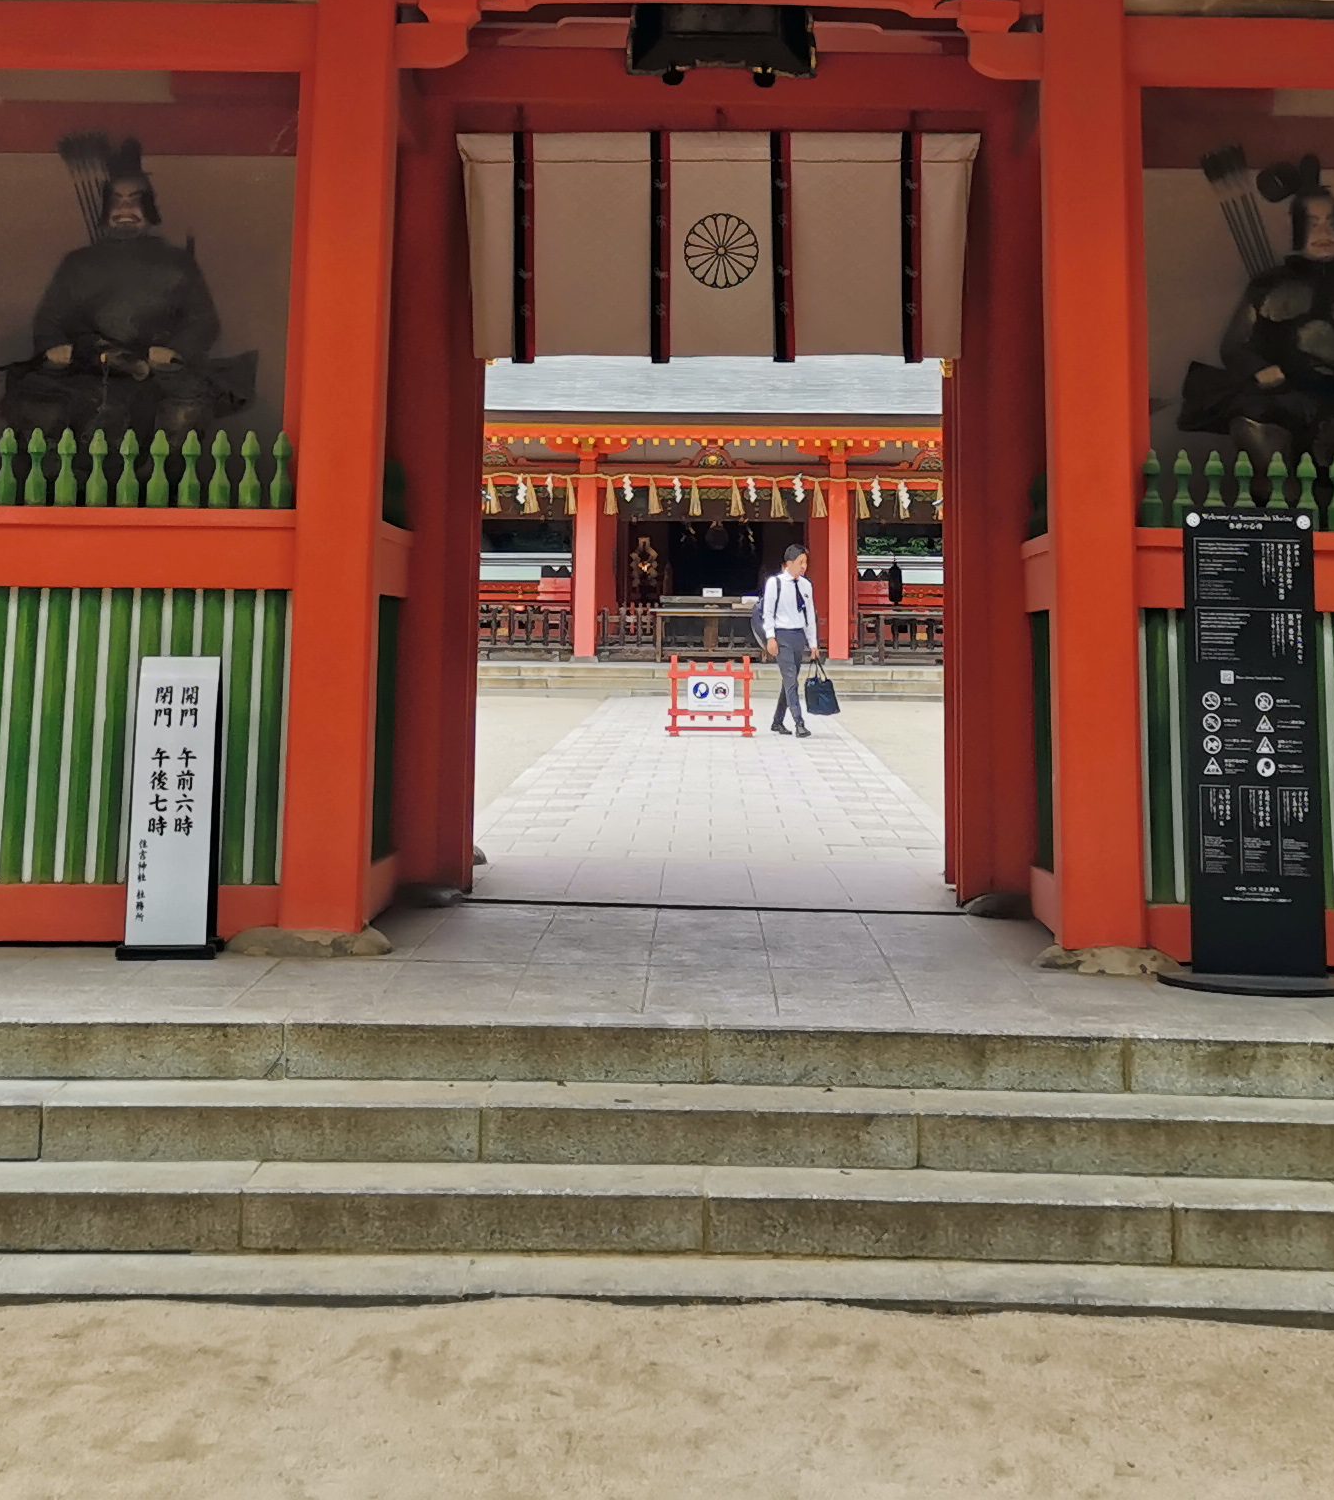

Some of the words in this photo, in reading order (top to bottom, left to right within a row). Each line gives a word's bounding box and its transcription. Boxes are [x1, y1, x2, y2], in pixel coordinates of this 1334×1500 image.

[153, 685, 174, 729] 閉門
[179, 685, 200, 729] 開門
[147, 747, 171, 837] 午後七時
[174, 747, 197, 837] 午前六時
